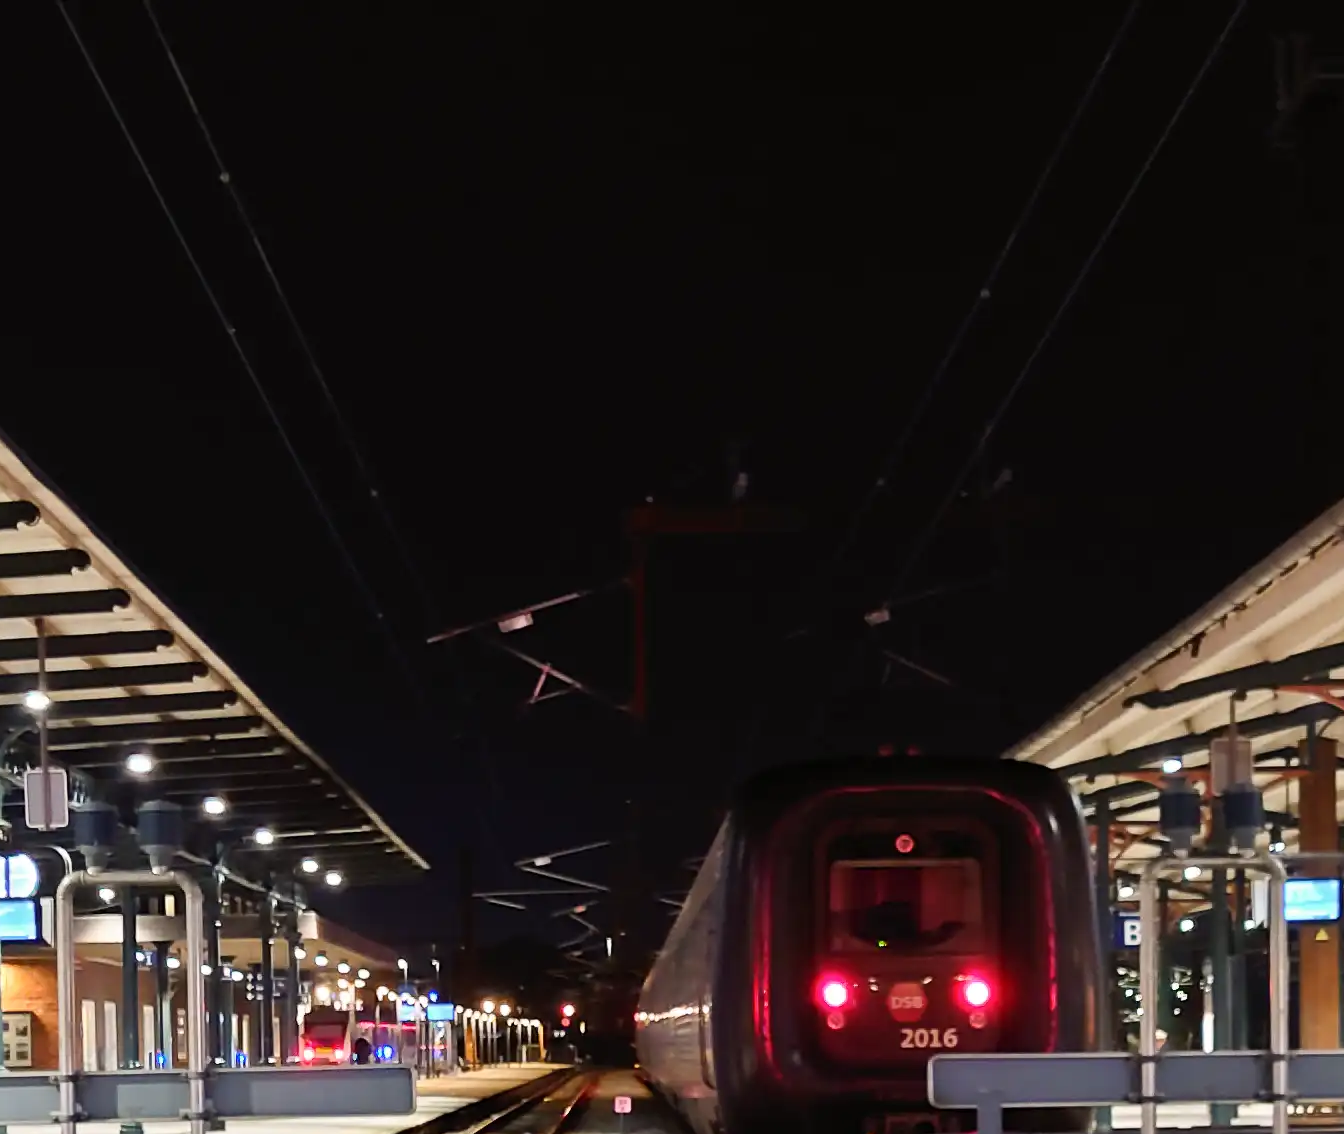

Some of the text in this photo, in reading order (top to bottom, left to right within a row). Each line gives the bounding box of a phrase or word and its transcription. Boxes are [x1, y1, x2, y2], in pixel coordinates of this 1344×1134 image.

[1123, 919, 1142, 946] B
[890, 995, 923, 1010] DSB
[900, 1027, 959, 1049] 2016
